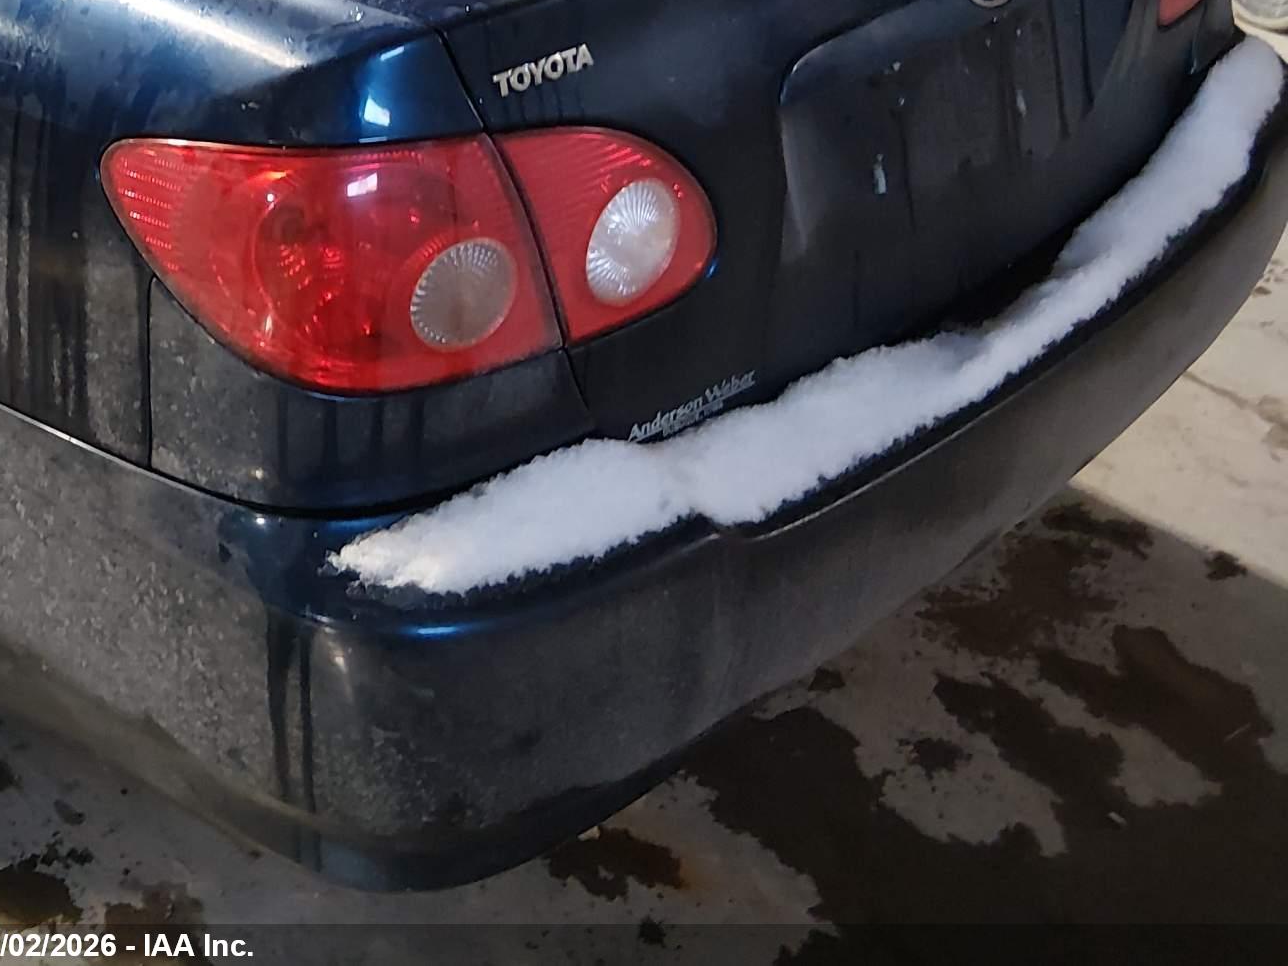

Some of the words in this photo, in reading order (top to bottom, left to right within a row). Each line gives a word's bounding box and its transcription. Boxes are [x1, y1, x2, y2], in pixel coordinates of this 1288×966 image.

[493, 43, 594, 98] TOYOTA
[628, 396, 703, 442] Anderson
[705, 370, 755, 402] Weber
